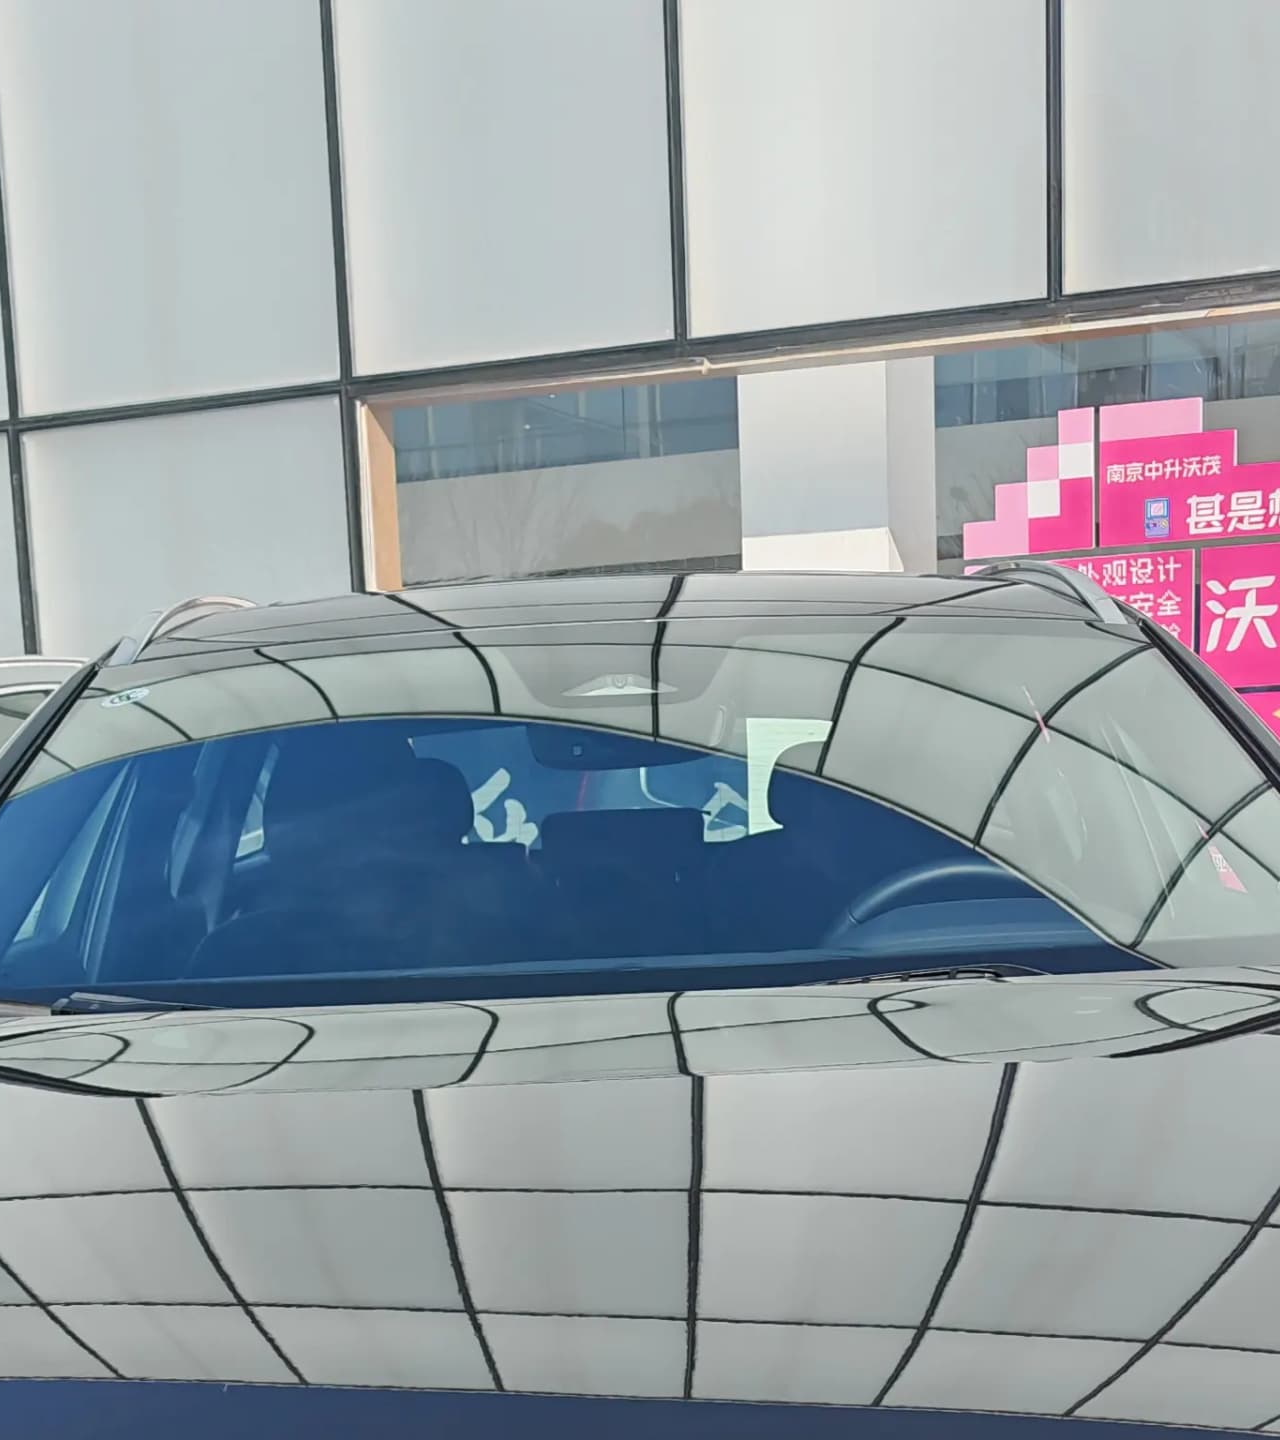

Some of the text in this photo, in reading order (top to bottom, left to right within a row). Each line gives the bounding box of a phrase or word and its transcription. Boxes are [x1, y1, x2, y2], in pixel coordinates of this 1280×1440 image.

[1106, 455, 1222, 484] 南京中升沃茂
[1110, 589, 1182, 618] 安全
